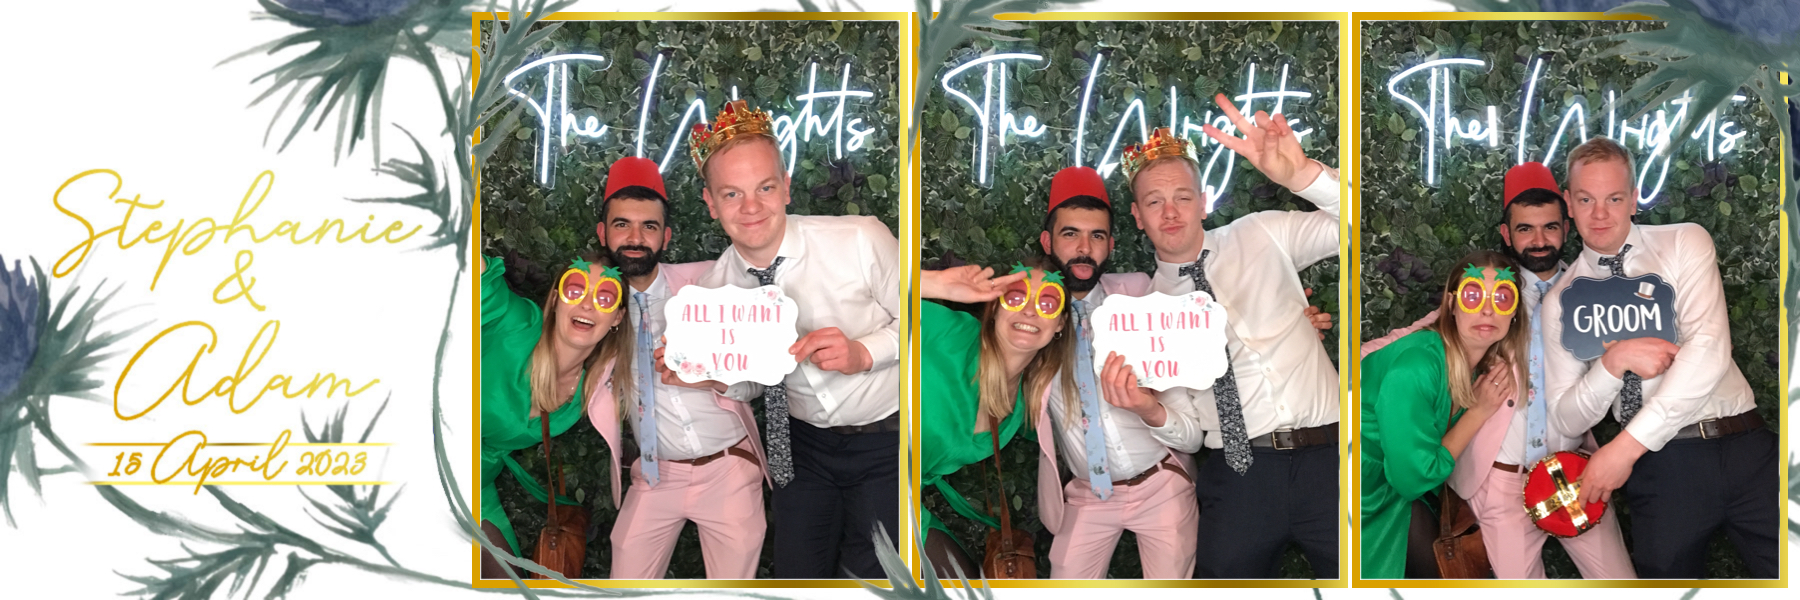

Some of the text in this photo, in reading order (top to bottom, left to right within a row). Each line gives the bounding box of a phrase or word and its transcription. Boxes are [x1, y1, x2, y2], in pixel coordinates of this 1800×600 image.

[504, 53, 610, 184] The
[941, 53, 1047, 184] The
[1387, 58, 1494, 185] The
[681, 303, 782, 324] ALL I WANT
[1108, 310, 1211, 332] ALL I WANT
[1572, 302, 1663, 338] GROOM
[720, 328, 736, 345] IS
[1149, 335, 1166, 353] IS
[711, 352, 749, 372] YOU
[1141, 359, 1180, 379] YOU
